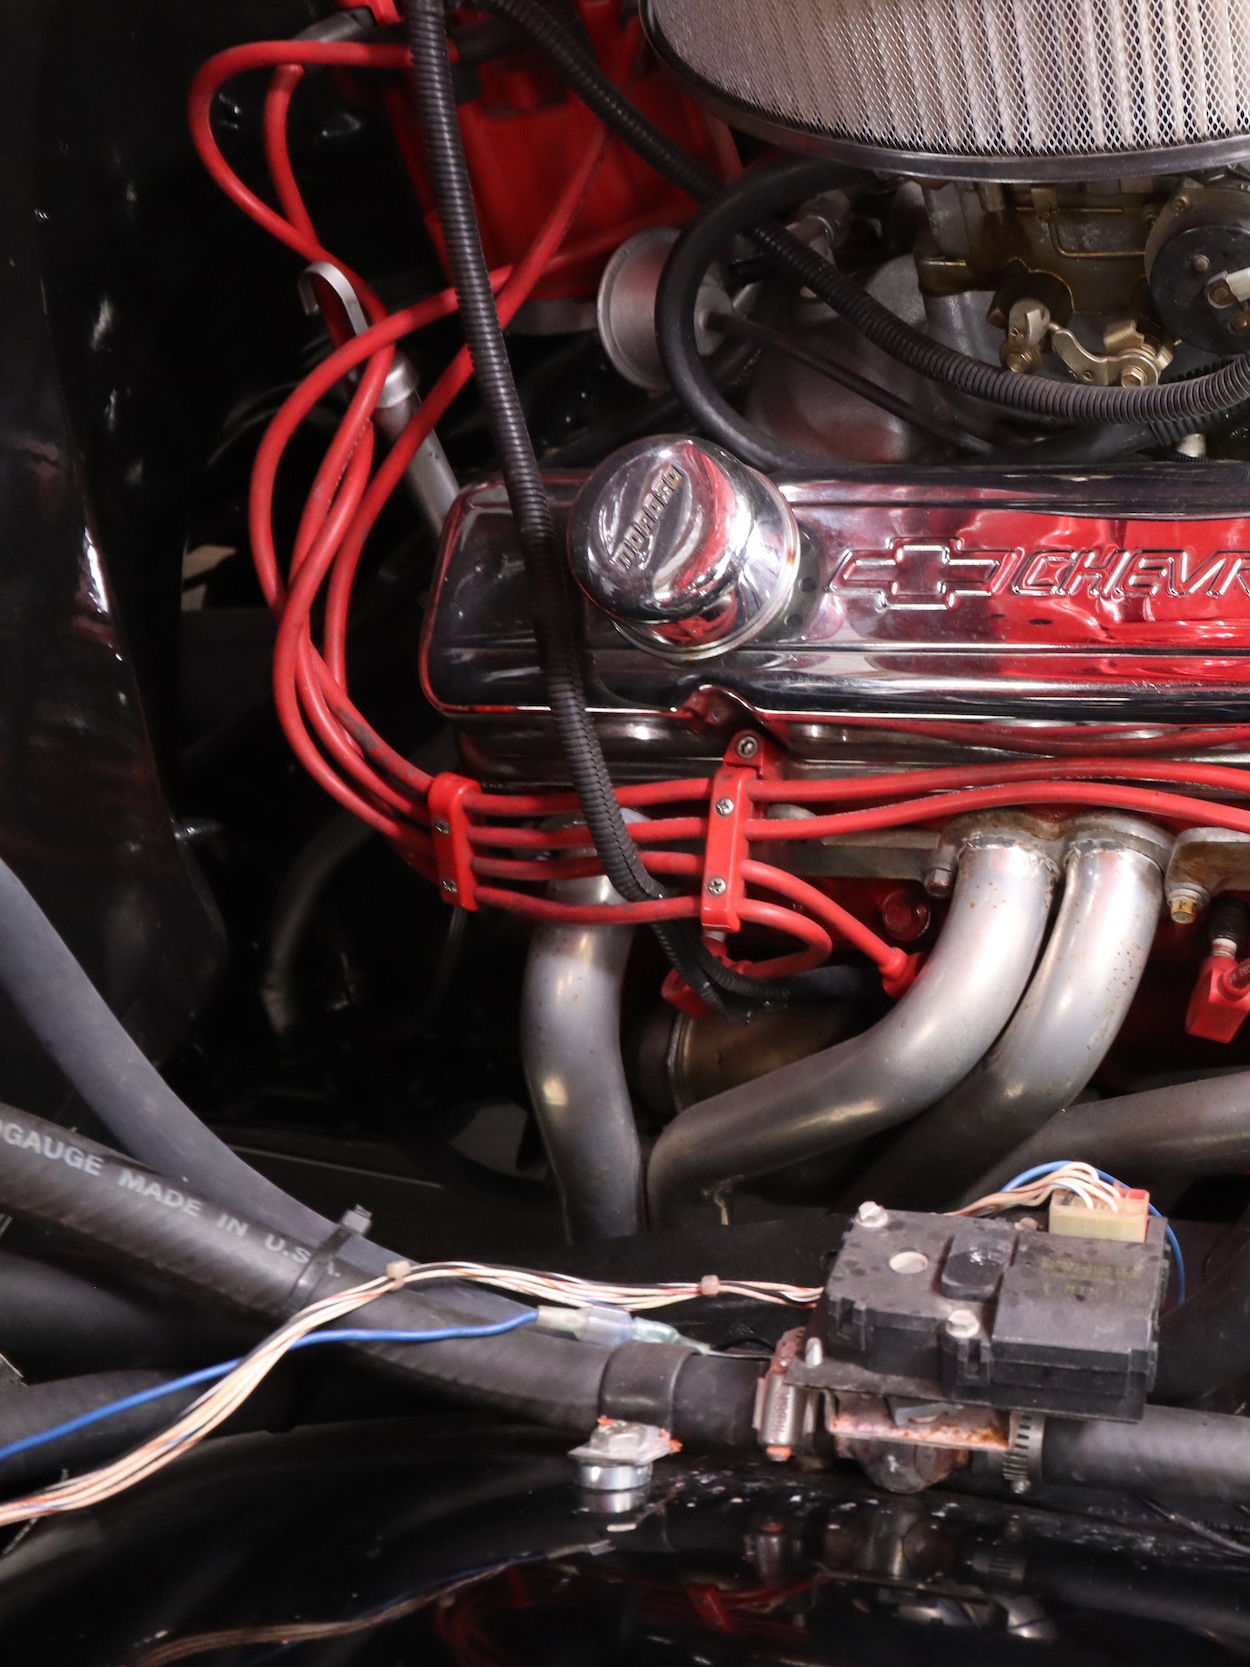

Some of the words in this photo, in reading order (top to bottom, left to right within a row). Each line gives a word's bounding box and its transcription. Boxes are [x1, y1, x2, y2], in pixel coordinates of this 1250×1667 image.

[0, 1118, 104, 1177] GAUGE
[117, 1168, 203, 1218] MADE
[216, 1212, 249, 1237] IN
